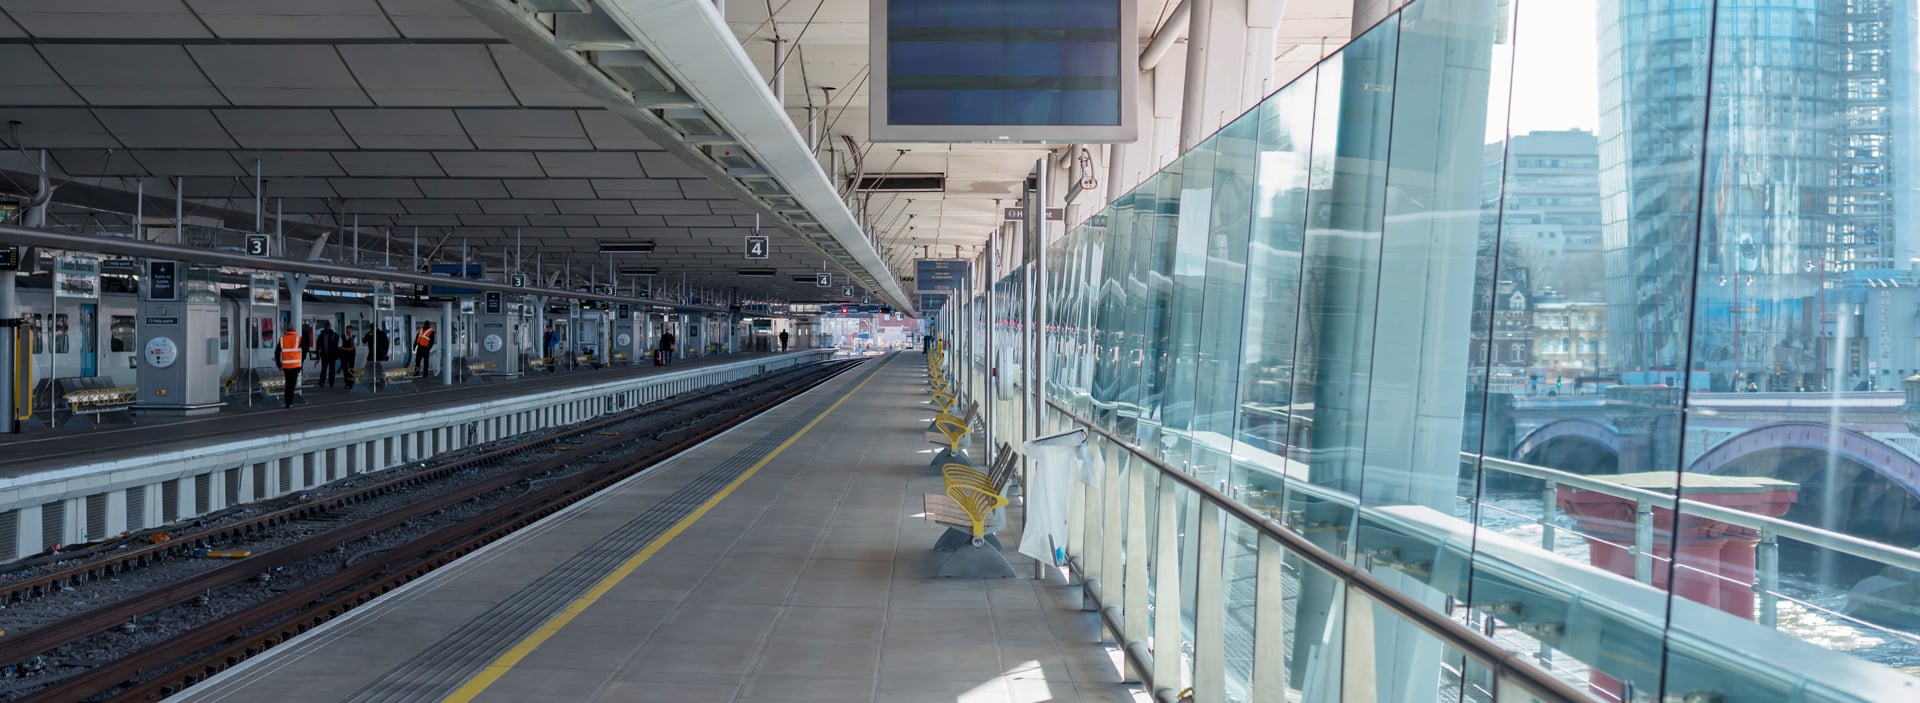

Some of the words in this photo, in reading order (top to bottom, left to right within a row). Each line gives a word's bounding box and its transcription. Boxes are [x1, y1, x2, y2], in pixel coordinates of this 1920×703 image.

[252, 240, 262, 254] 3
[752, 242, 762, 255] 4
[515, 277, 521, 287] 3
[820, 276, 828, 286] 4
[607, 286, 613, 295] 3
[845, 288, 851, 296] 4
